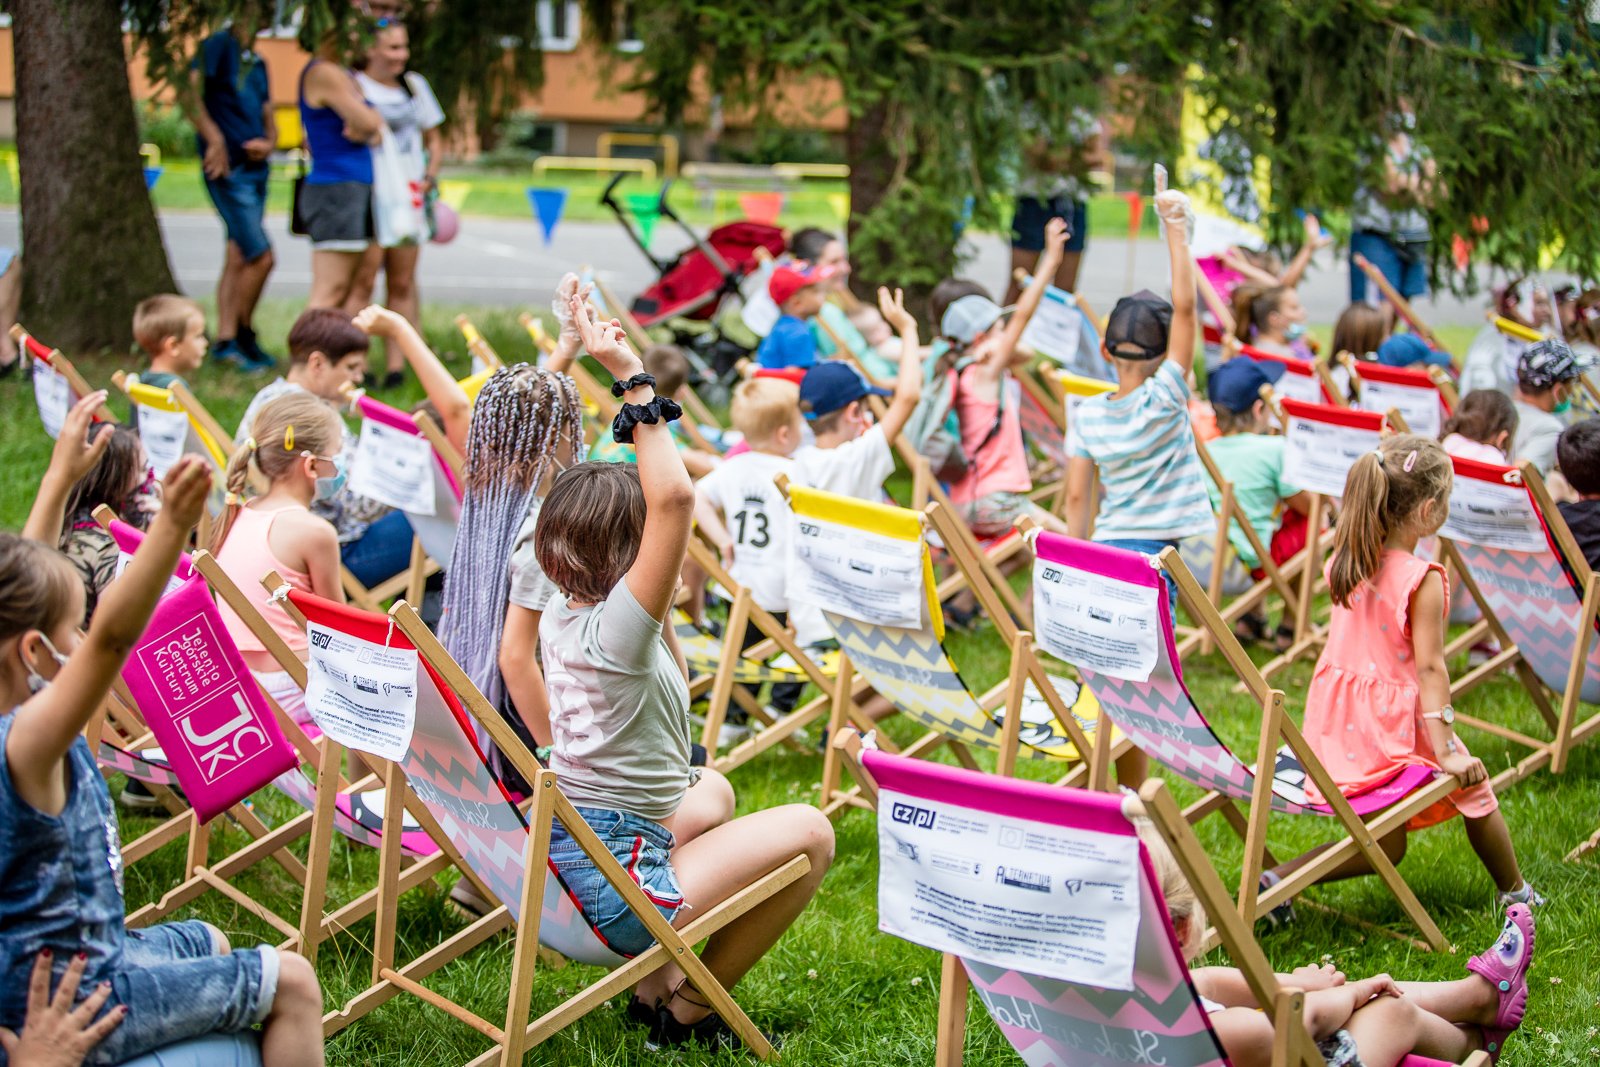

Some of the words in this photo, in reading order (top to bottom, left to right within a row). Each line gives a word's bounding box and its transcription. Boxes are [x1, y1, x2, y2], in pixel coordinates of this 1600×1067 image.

[734, 510, 770, 548] 13
[153, 646, 186, 701] Kultury
[167, 640, 199, 695] Centrum
[180, 641, 211, 687] górskie
[182, 627, 220, 681] Jelenio
